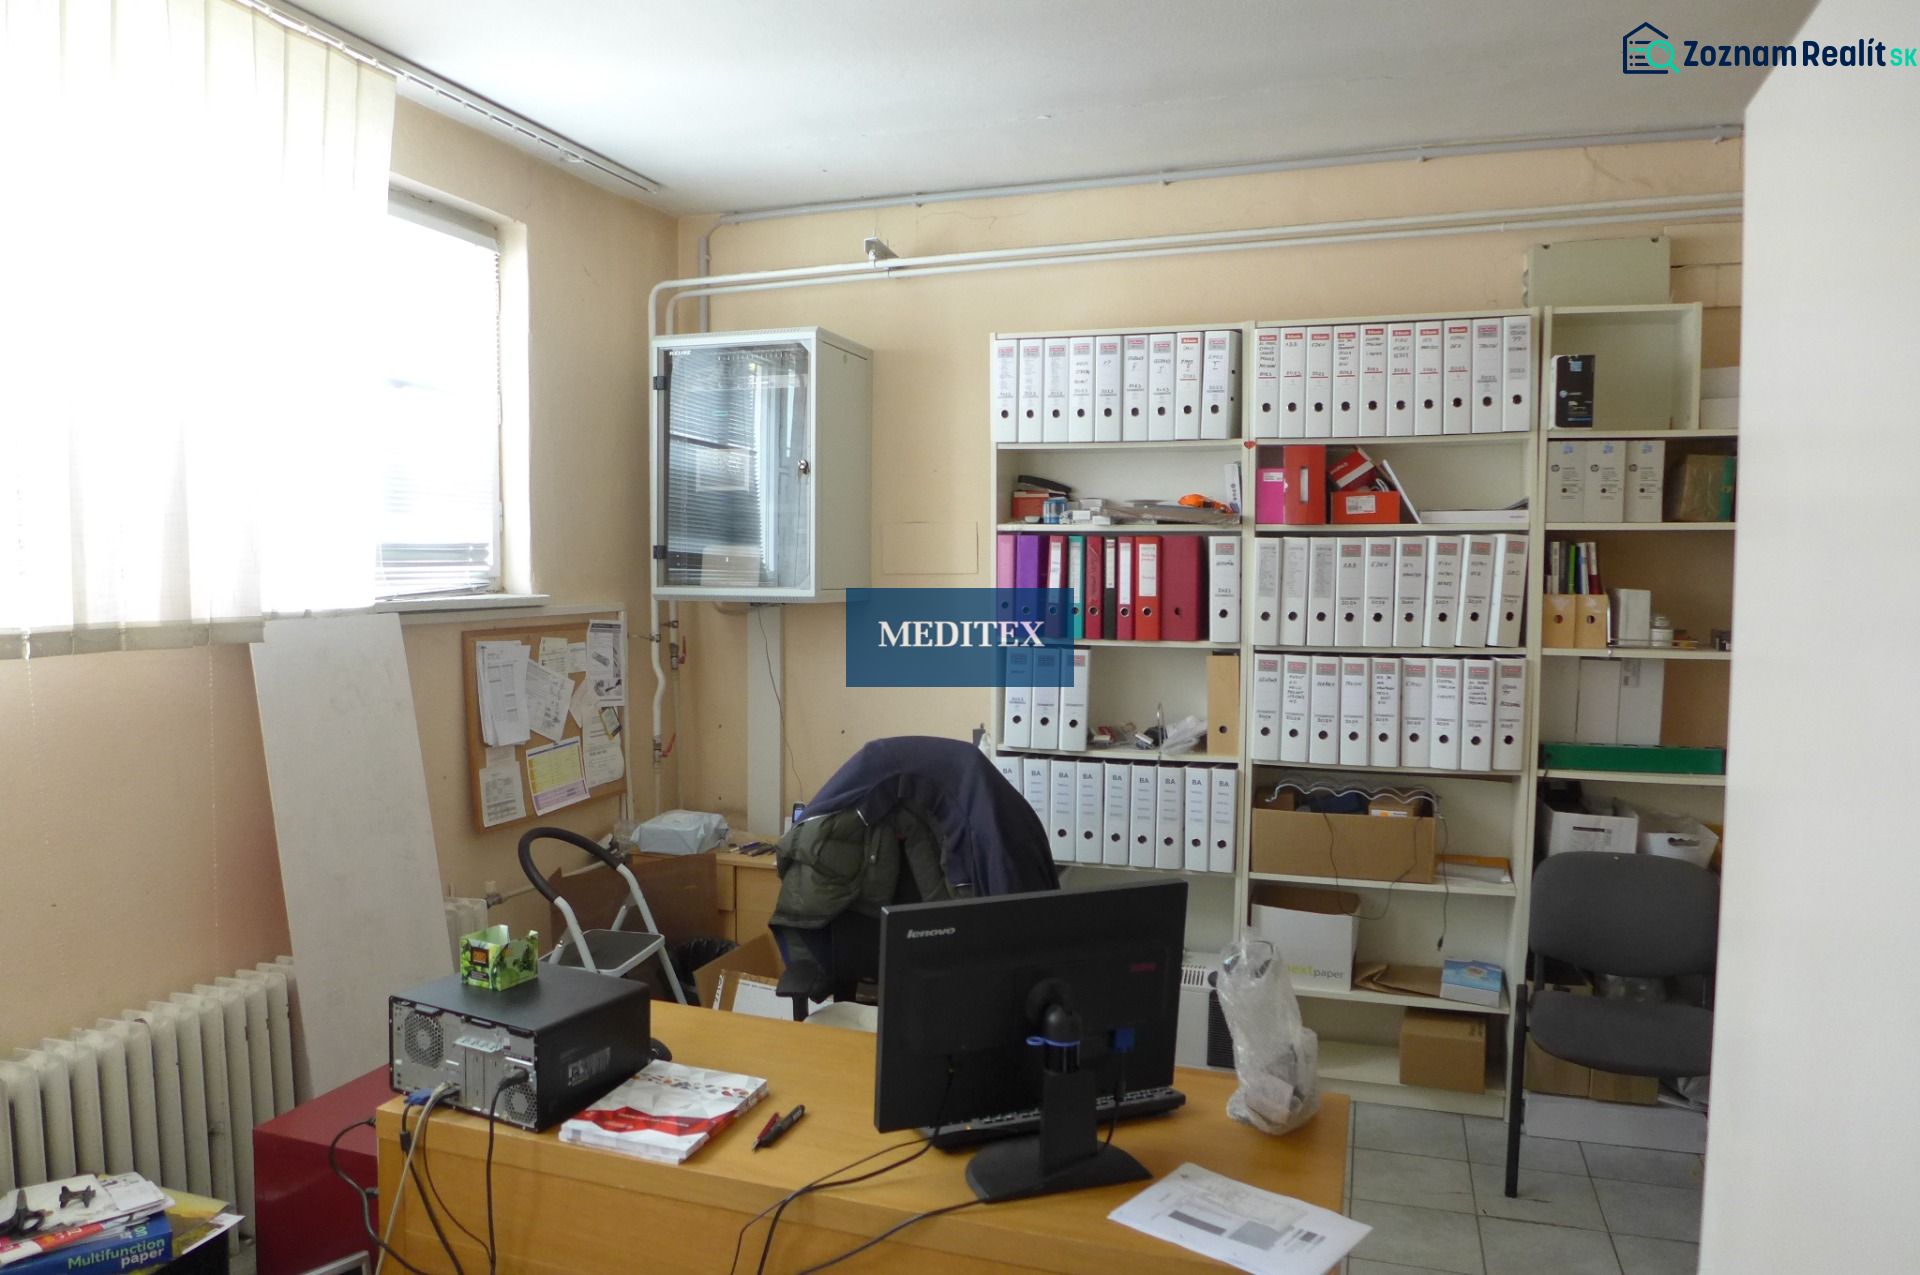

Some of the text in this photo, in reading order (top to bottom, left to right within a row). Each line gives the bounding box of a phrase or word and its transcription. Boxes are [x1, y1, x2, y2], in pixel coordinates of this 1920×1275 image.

[906, 927, 956, 939] lenovo
[67, 1238, 165, 1270] Multifunction
[120, 1247, 165, 1269] paper
